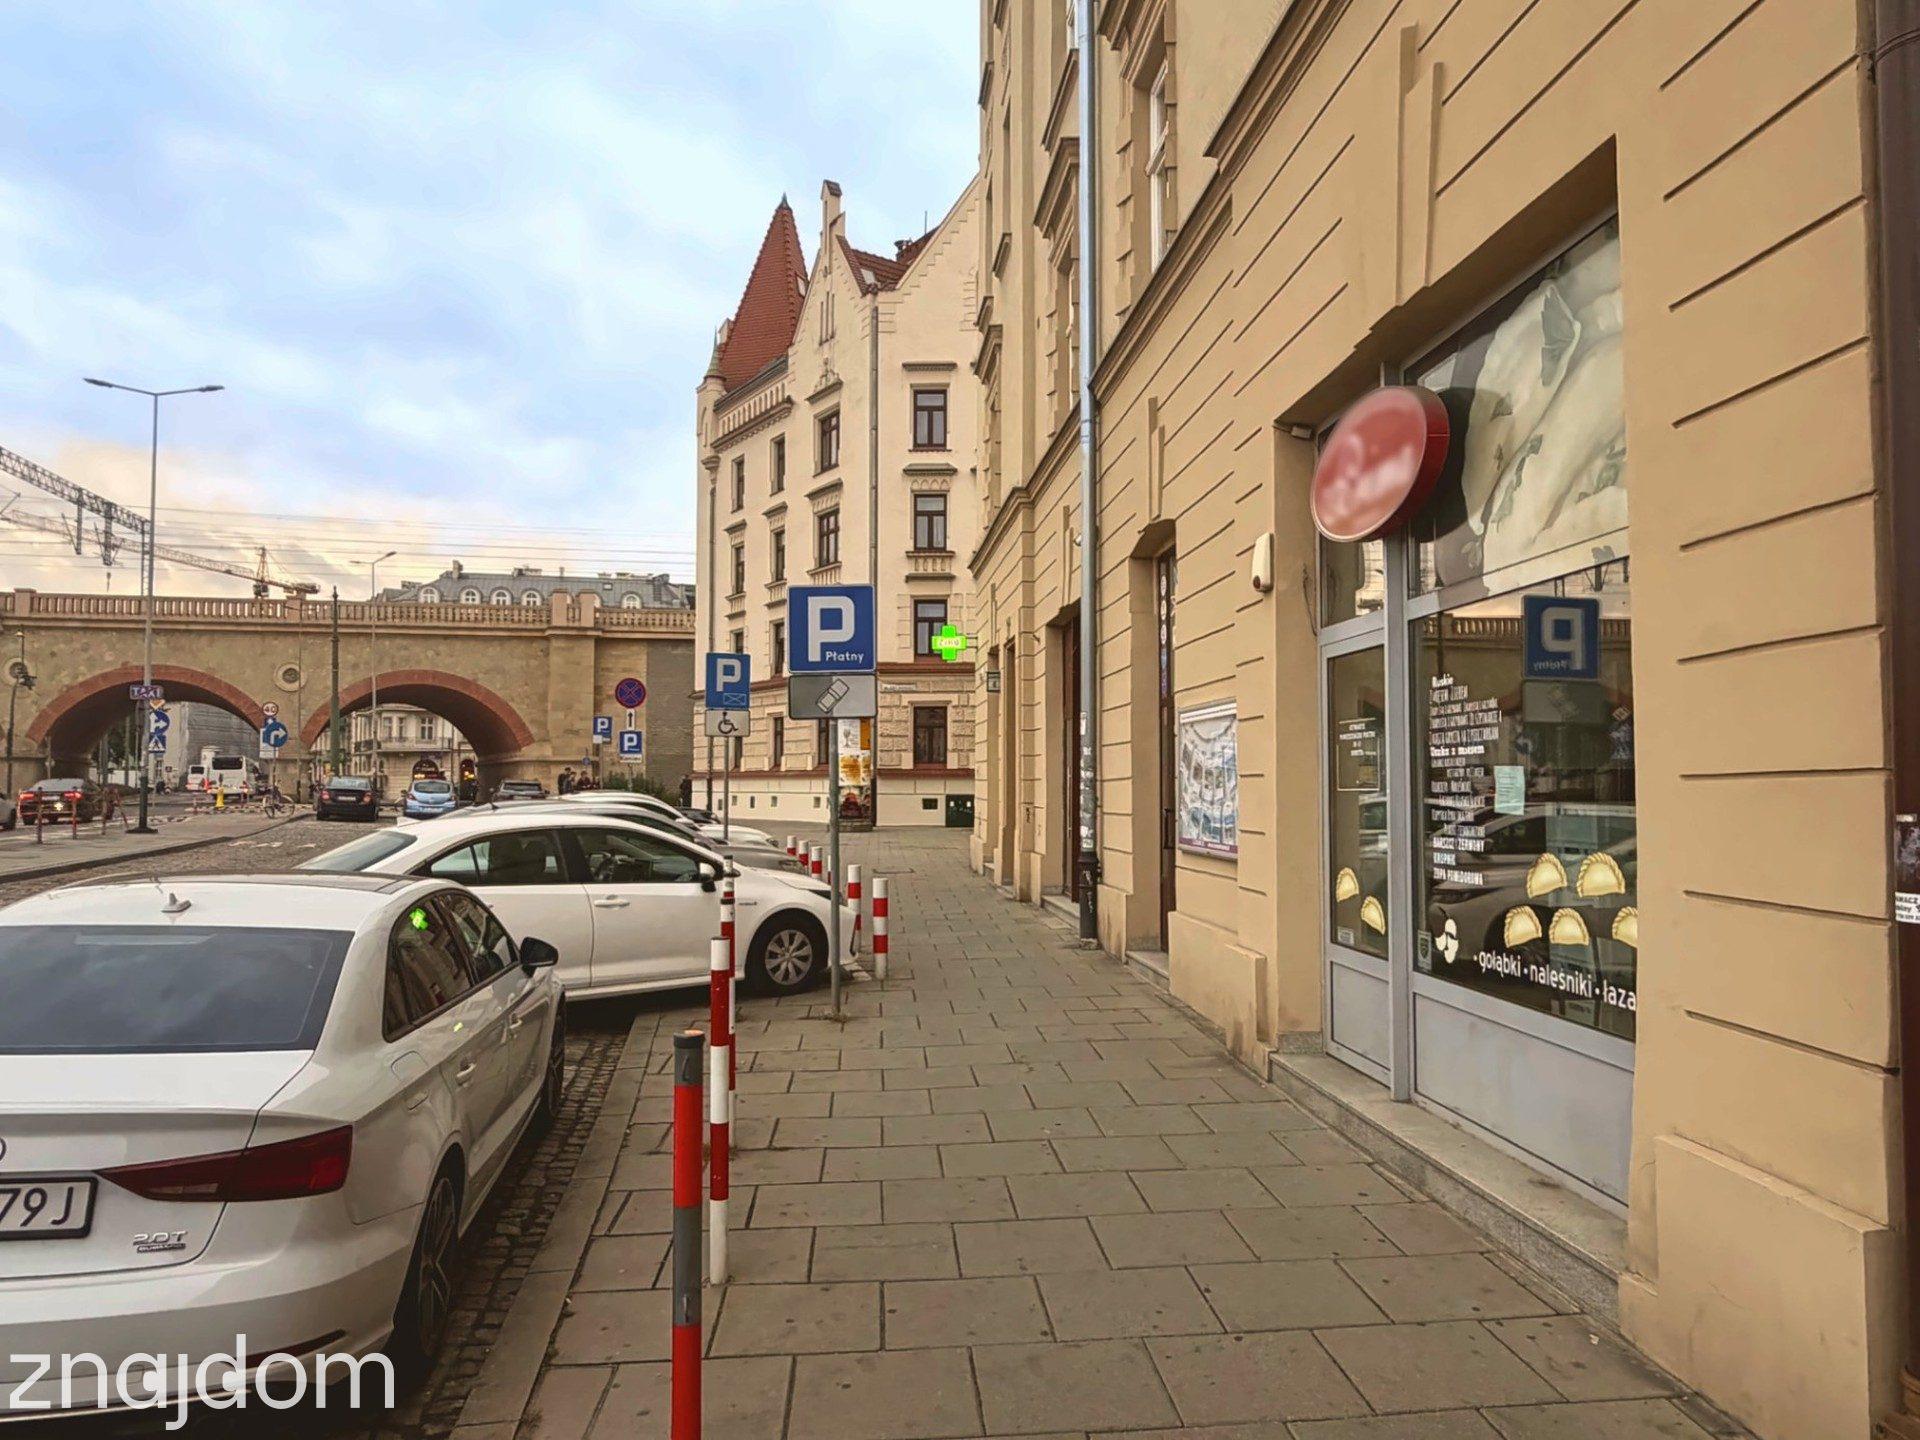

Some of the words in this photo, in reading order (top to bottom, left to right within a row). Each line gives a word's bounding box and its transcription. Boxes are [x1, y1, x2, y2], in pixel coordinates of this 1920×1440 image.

[807, 596, 855, 662] P
[825, 650, 864, 664] Płatny
[716, 658, 742, 692] P
[132, 686, 160, 698] TAXI
[265, 704, 276, 714] 40
[597, 717, 609, 733] P
[623, 733, 638, 751] P
[1479, 950, 1522, 978] gołąbki
[1529, 963, 1593, 998] naleśniki
